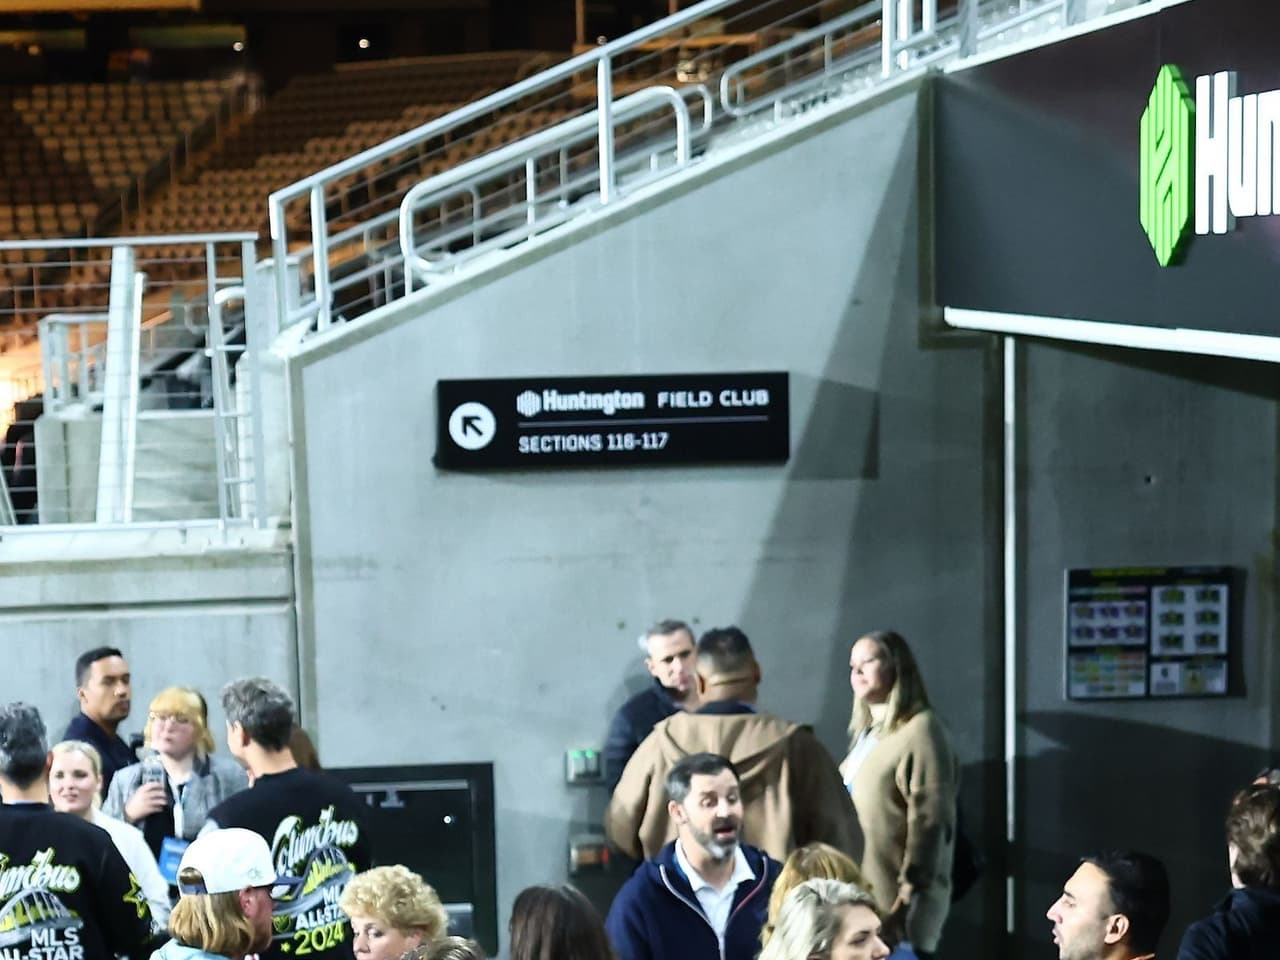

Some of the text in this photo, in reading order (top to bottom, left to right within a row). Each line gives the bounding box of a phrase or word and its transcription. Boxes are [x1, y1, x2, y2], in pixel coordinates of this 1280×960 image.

[543, 389, 770, 416] Huntington FIELD CLUB
[518, 434, 601, 453] SECTIONS
[271, 804, 359, 899] Columbus
[322, 885, 342, 906] ML
[30, 926, 81, 948] MLS
[293, 920, 346, 955] 2024
